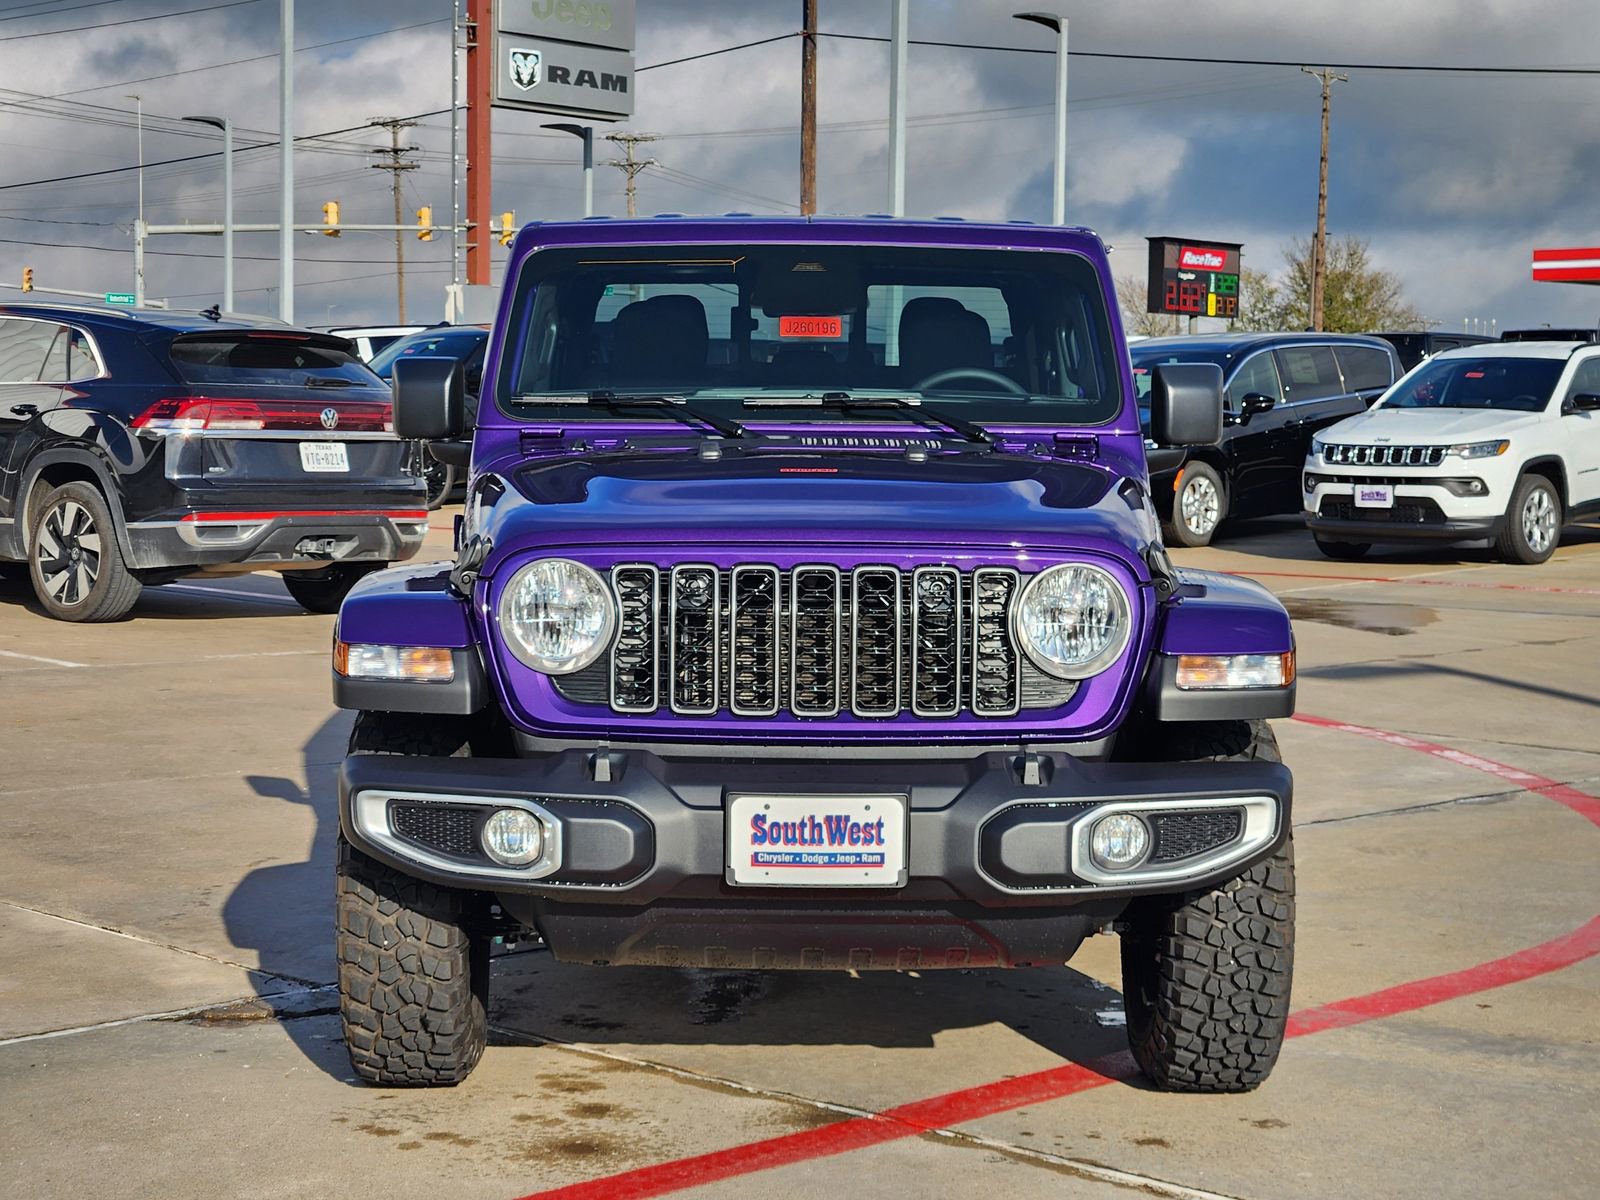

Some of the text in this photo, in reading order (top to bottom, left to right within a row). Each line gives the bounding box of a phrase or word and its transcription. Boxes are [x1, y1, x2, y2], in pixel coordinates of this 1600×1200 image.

[547, 64, 628, 94] RAM
[1182, 250, 1223, 267] RaceTrac
[784, 321, 837, 334] J260196
[314, 444, 332, 452] TEXAS
[750, 813, 886, 847] SouthWest
[757, 853, 881, 864] Chrysler Dodge Jeep Ram
